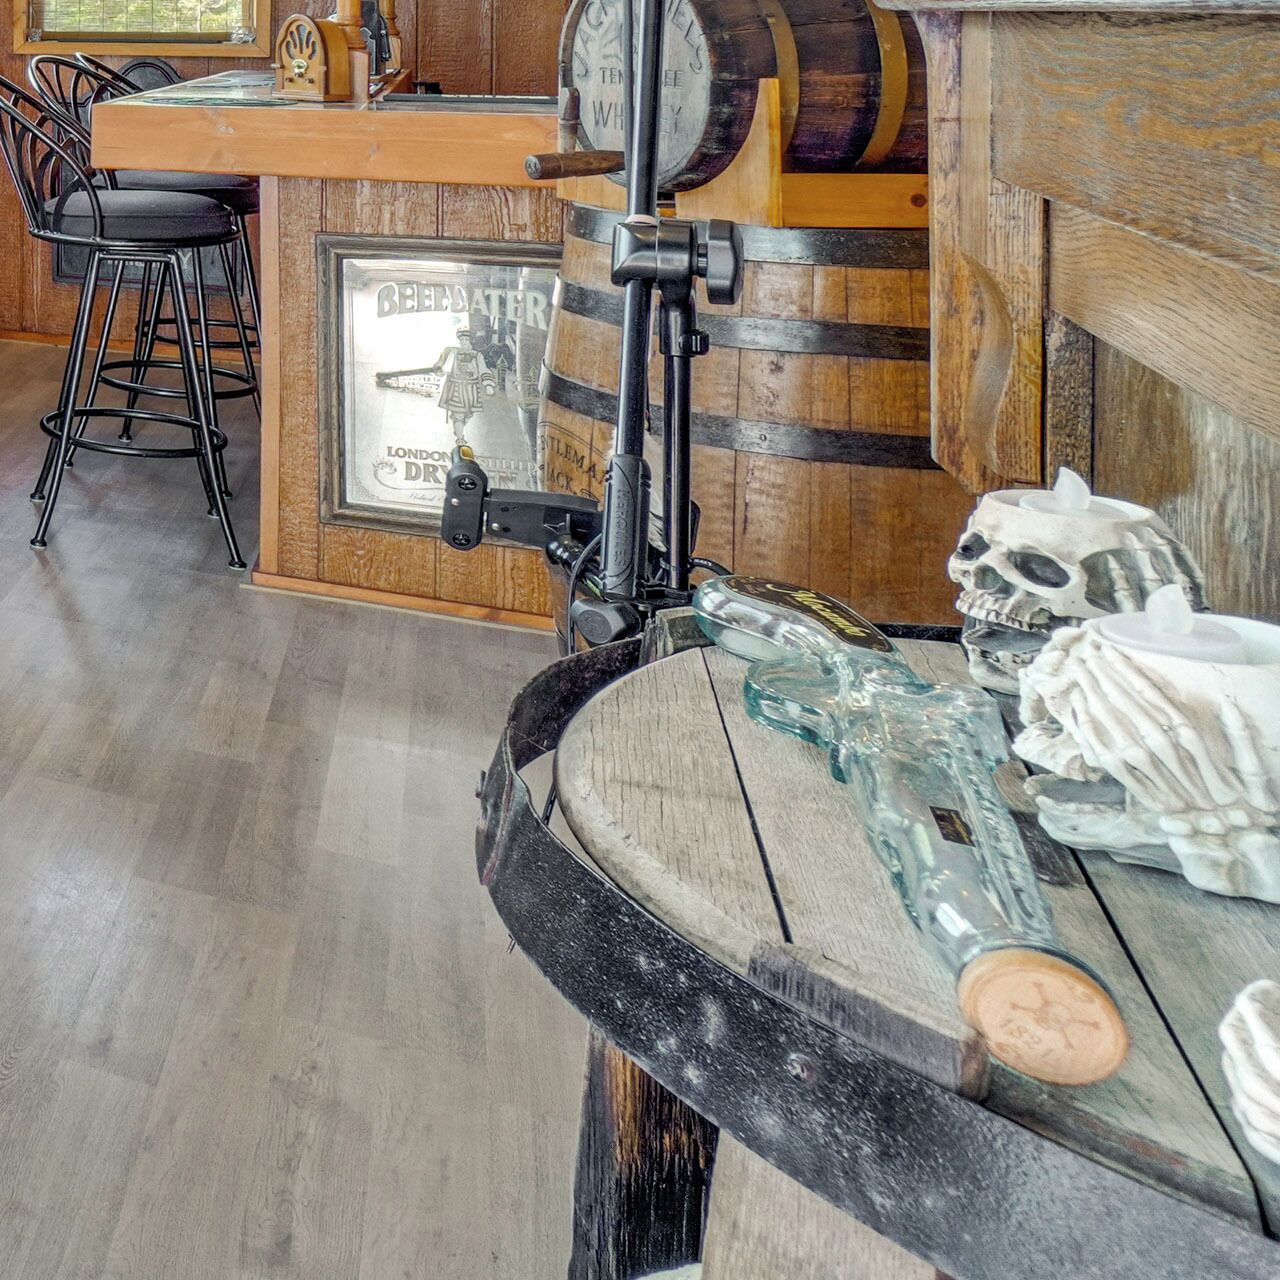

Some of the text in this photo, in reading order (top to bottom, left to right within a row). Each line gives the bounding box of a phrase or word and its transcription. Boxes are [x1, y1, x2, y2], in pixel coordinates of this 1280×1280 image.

[592, 100, 682, 136] WHEY
[376, 282, 548, 331] BEEFEATER
[386, 445, 452, 462] LONDON
